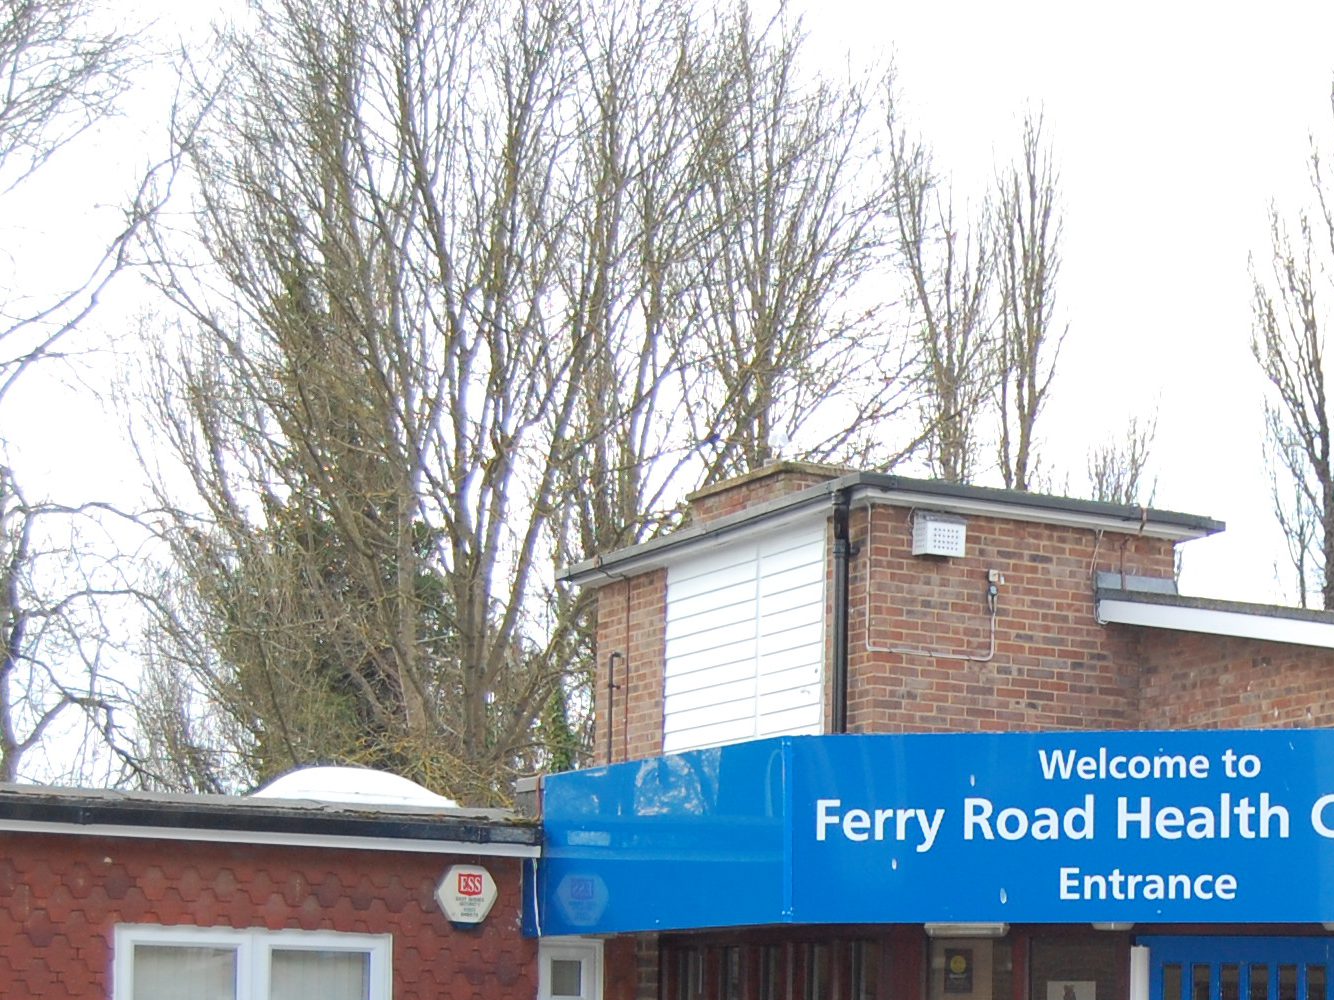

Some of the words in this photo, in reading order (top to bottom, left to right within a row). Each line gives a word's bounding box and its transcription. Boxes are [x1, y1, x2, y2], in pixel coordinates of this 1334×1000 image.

[1038, 747, 1210, 780] Welcome
[1221, 748, 1262, 778] to
[815, 799, 946, 853] Ferry
[963, 793, 1095, 841] Road
[1117, 792, 1290, 840] Health
[460, 876, 481, 892] ESS
[1059, 866, 1238, 901] Entrance
